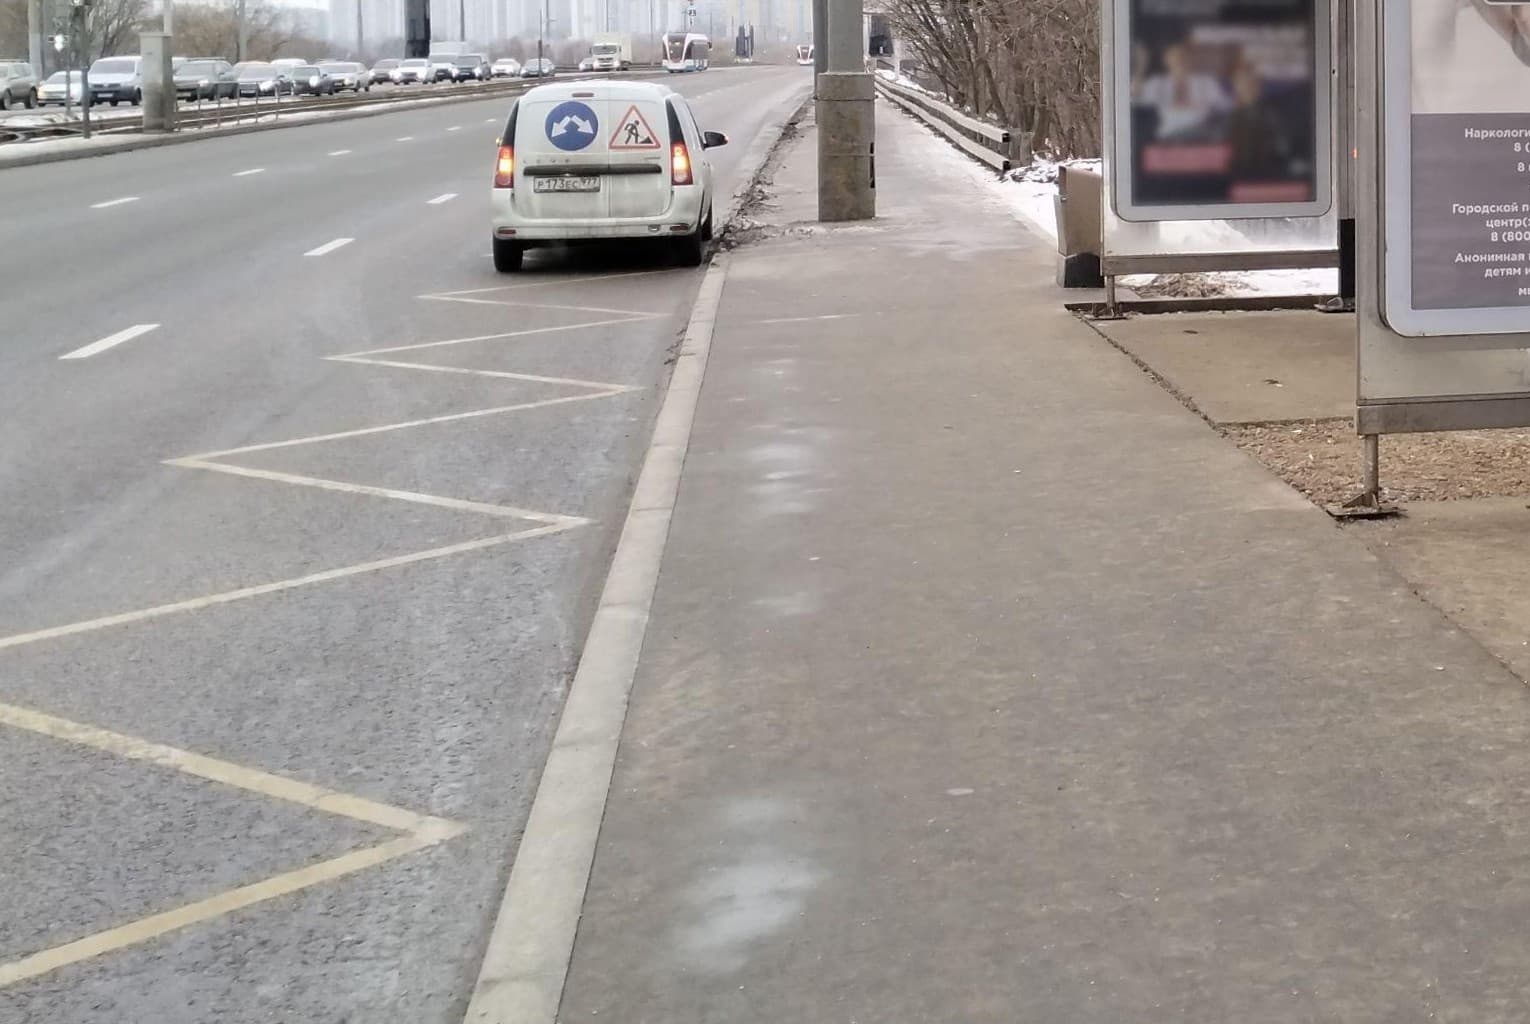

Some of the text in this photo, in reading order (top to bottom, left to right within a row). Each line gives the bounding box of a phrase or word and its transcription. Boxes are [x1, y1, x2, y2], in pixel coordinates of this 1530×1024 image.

[1514, 142, 1522, 152] 8
[1517, 162, 1525, 172] 8
[1452, 202, 1518, 216] Городской
[1491, 232, 1499, 242] 8
[1455, 252, 1525, 263] Анонимная
[1484, 265, 1522, 278] детям
